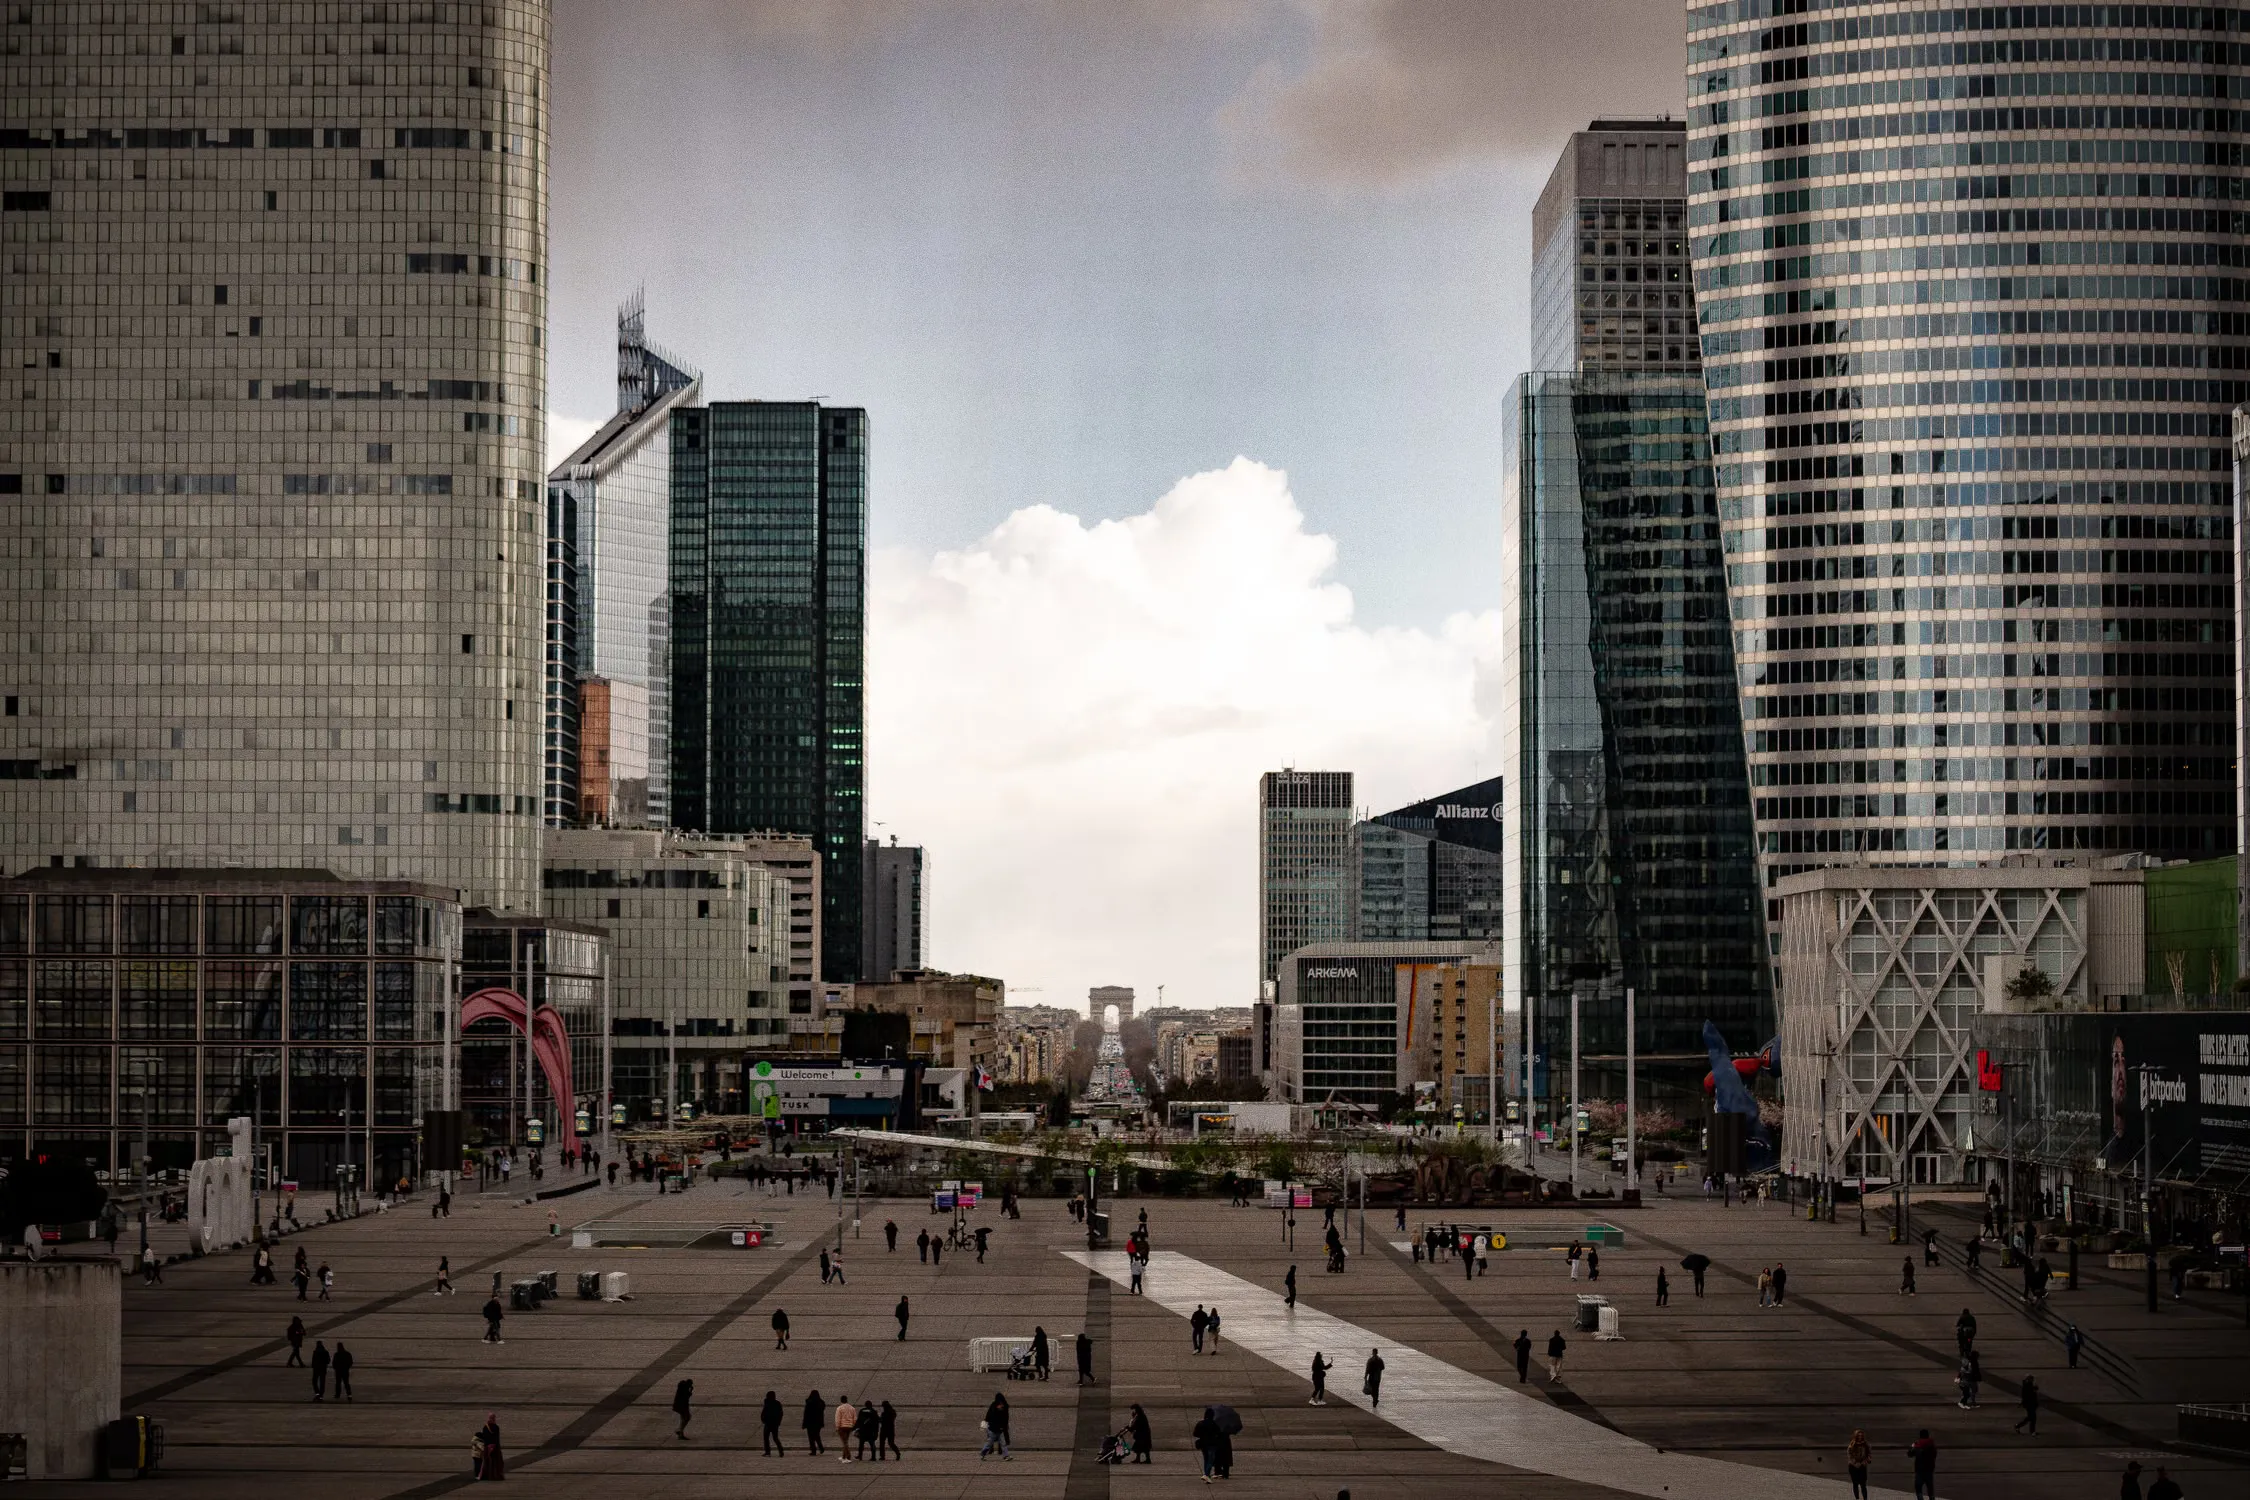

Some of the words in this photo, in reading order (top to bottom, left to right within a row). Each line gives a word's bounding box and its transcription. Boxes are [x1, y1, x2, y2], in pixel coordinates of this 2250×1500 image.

[1435, 804, 1489, 819] Allianz
[1307, 967, 1358, 978] ARKEMA
[2199, 1033, 2215, 1065] TOUS
[2215, 1034, 2227, 1066] LES
[2227, 1034, 2249, 1067] ACTIFS
[781, 1070, 829, 1079] Welcome
[2149, 1072, 2187, 1108] bitpanda
[2199, 1073, 2216, 1105] TOUS
[2216, 1074, 2227, 1106] LES
[781, 1101, 809, 1109] TUSK
[749, 1234, 759, 1243] A
